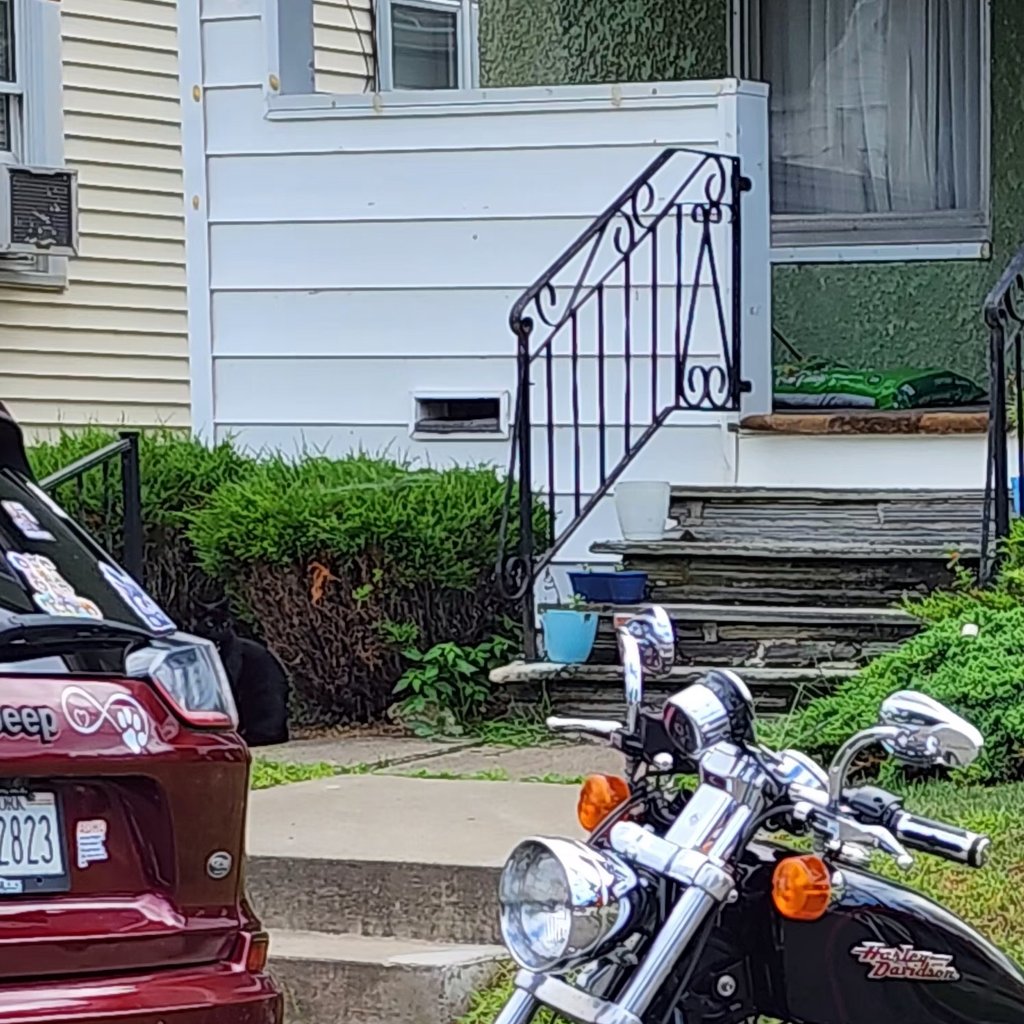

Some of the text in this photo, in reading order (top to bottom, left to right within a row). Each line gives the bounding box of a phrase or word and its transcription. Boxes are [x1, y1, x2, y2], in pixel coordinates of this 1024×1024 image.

[0, 707, 57, 741] eep
[855, 943, 951, 966] Harley
[872, 961, 958, 979] Davidson
